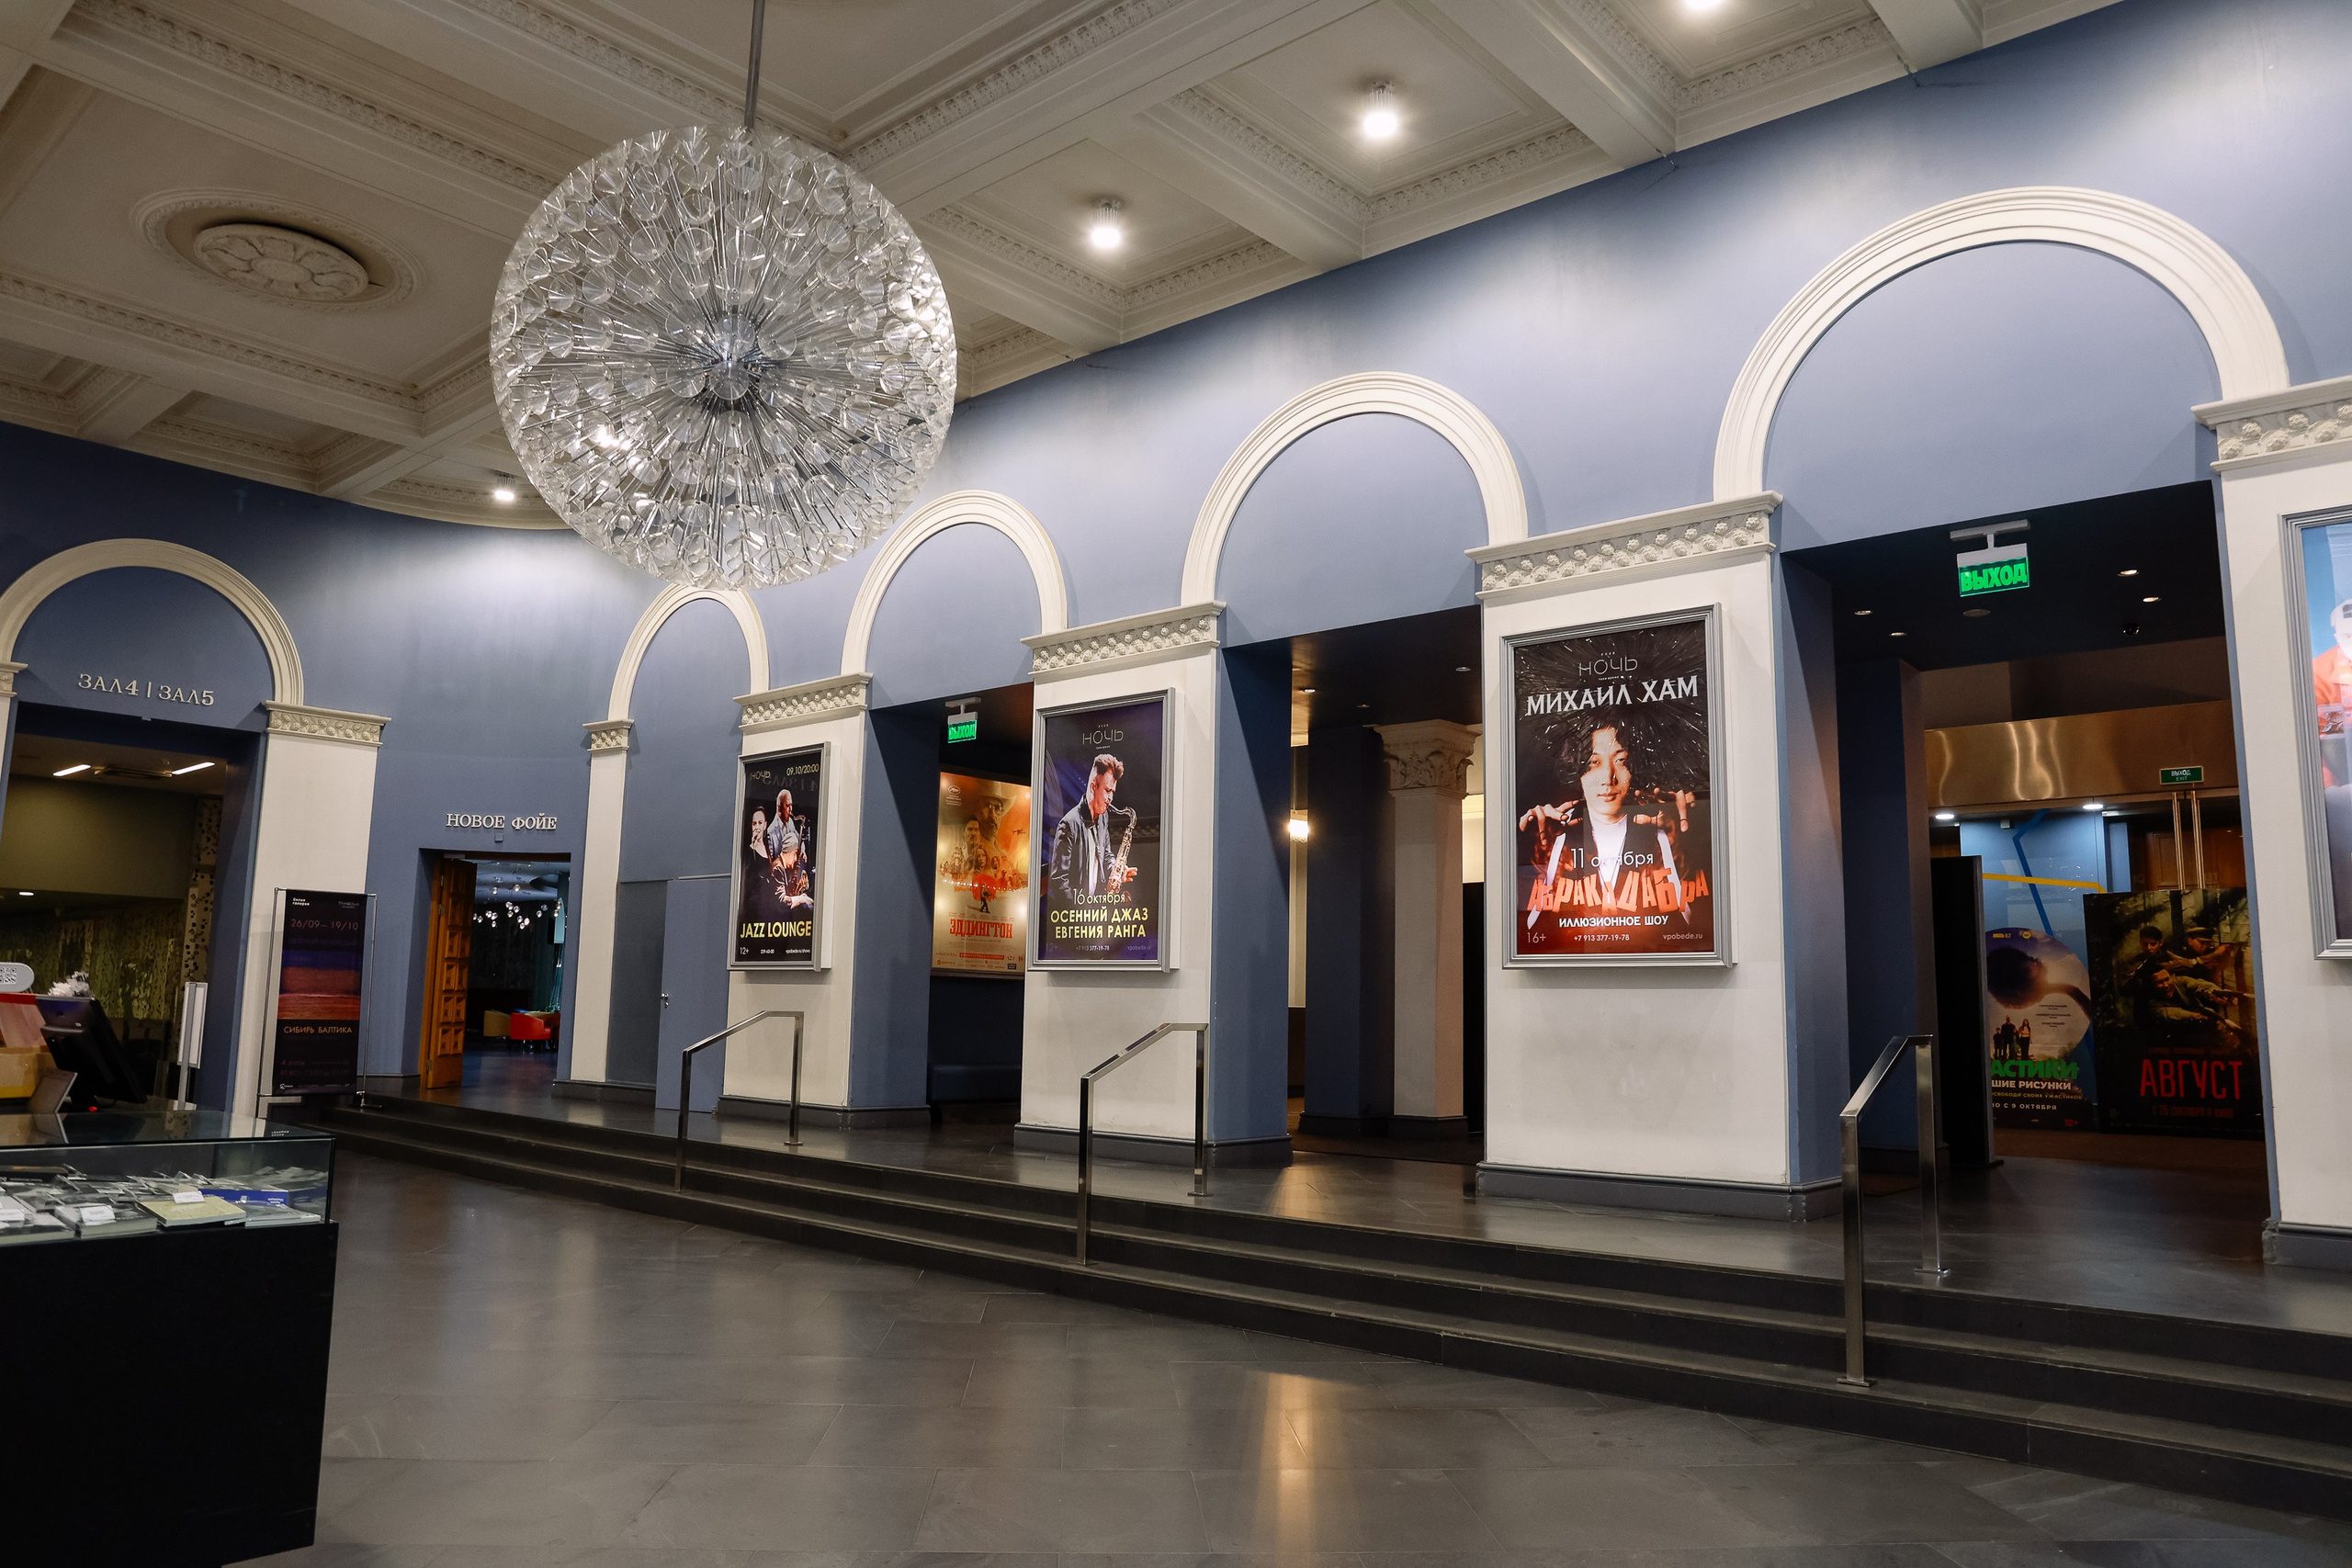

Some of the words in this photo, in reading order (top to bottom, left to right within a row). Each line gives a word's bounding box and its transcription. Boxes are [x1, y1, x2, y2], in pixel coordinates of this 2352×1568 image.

[1961, 563, 2028, 592] ВЫХОД
[1578, 655, 1638, 677] НОЧЬ
[77, 673, 140, 696] ЗАЛ4
[158, 685, 215, 706] ЗАЛ5
[1525, 684, 1633, 716] МИХАИЛ
[1641, 675, 1699, 703] ХАМ
[948, 724, 976, 740] ВЫХОД
[1082, 728, 1125, 745] НОЧЬ
[446, 813, 505, 829] НОВОЕ
[511, 812, 558, 829] ФОЙЕ
[1570, 848, 1585, 869] 11
[1073, 888, 1086, 905] 16
[1087, 892, 1125, 906] октября
[1050, 906, 1108, 923] ОСЕННИЙ
[1111, 907, 1148, 923] ДЖАЗ
[1559, 916, 1642, 928] ИЛЛЮЗИОННОЕ
[1645, 915, 1669, 926] ШОУ
[331, 920, 358, 931] 19/10
[740, 922, 765, 939] JAZZ
[767, 920, 812, 938] LOUNGE
[950, 919, 1013, 939] ЭДДИНГТОН
[1055, 925, 1103, 939] ЕВГЕНИЯ
[1108, 924, 1147, 938] РАНГА
[1526, 931, 1546, 944] 16+
[1596, 933, 1630, 942] 377-19-78
[1663, 932, 1703, 941] vpobede.ru
[740, 947, 750, 955] 12+
[283, 1026, 315, 1034] СИБИРЬ
[318, 1026, 353, 1034] БАЛТИКА
[2018, 1080, 2072, 1090] РИСУНКИ
[2140, 1059, 2243, 1100] АВГУСТ
